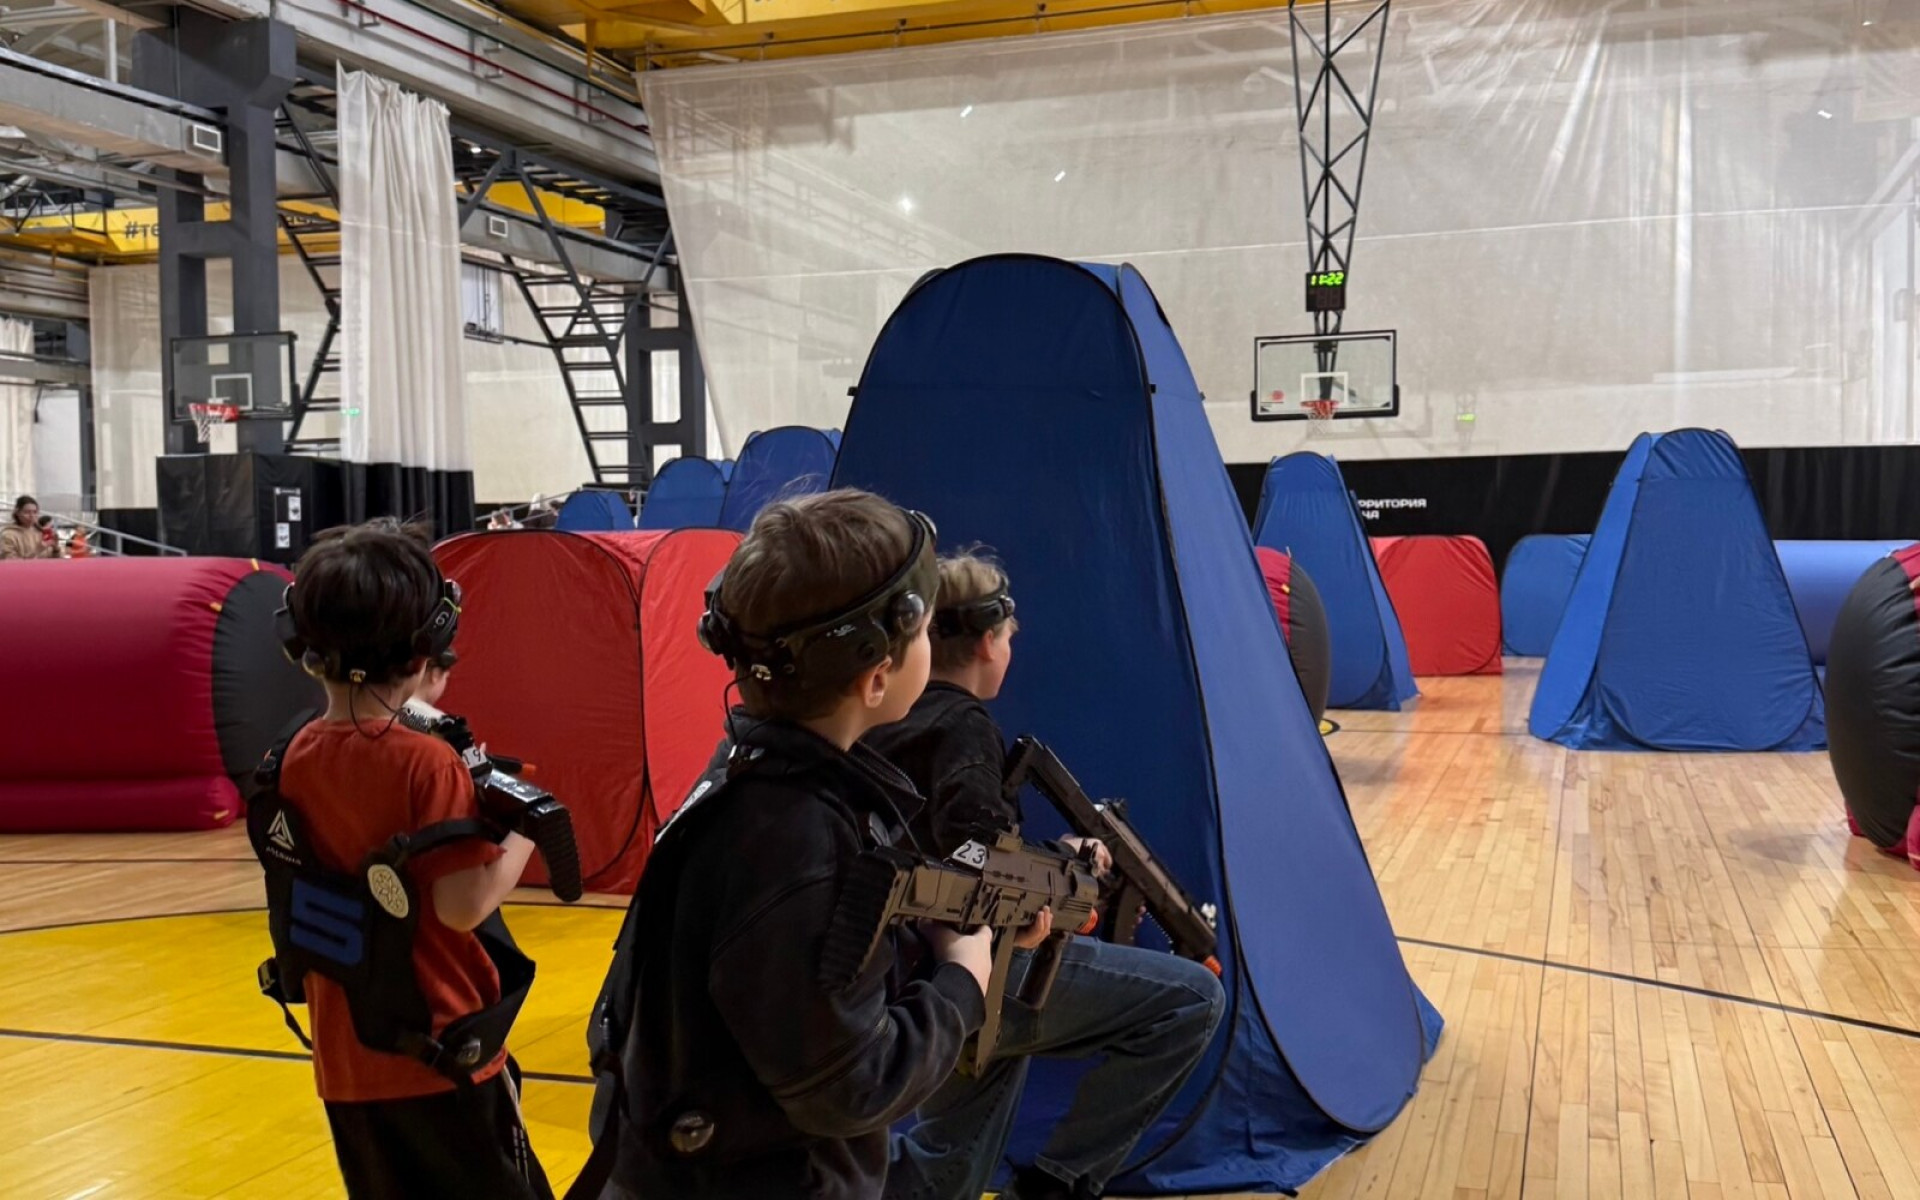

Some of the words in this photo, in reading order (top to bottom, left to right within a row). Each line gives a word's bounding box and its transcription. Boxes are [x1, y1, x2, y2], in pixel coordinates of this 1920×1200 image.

[1311, 271, 1345, 286] 11:22
[1357, 498, 1427, 509] РРИТОРИЯ
[1361, 510, 1380, 520] ЧА
[956, 843, 985, 864] 23
